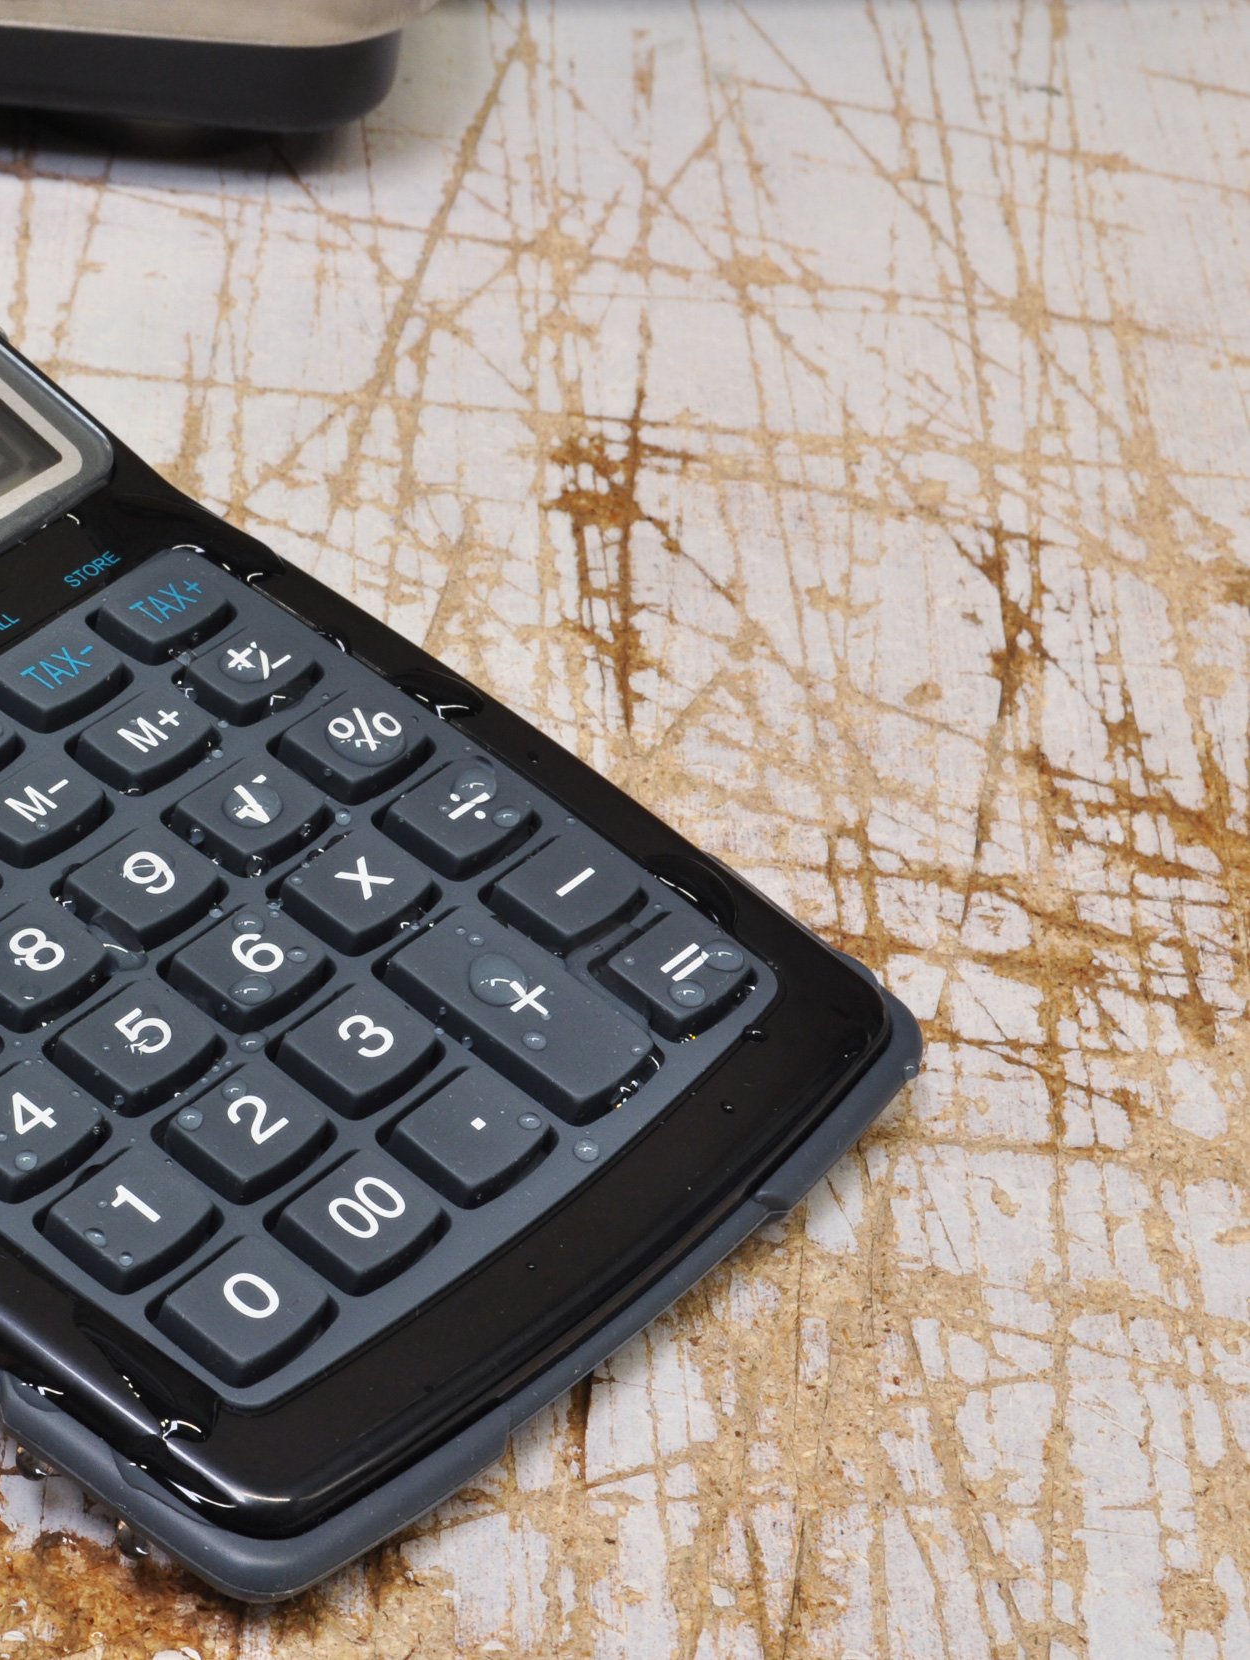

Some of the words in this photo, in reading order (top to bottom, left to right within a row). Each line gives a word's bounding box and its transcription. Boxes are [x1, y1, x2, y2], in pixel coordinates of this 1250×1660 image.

[63, 551, 121, 588] STORE
[129, 577, 202, 625] TAX+
[20, 644, 94, 691] TAX-
[116, 709, 180, 753] M+
[327, 707, 402, 752] %
[4, 778, 69, 823] M-
[123, 851, 176, 895] 9
[9, 927, 65, 972] 8
[231, 933, 285, 973] 6
[114, 1007, 172, 1054] 5
[338, 1014, 394, 1058] 3
[11, 1091, 57, 1135] 4
[227, 1095, 290, 1145] 2
[110, 1184, 161, 1223] 1
[328, 1176, 407, 1239] 00
[223, 1272, 280, 1319] 0
